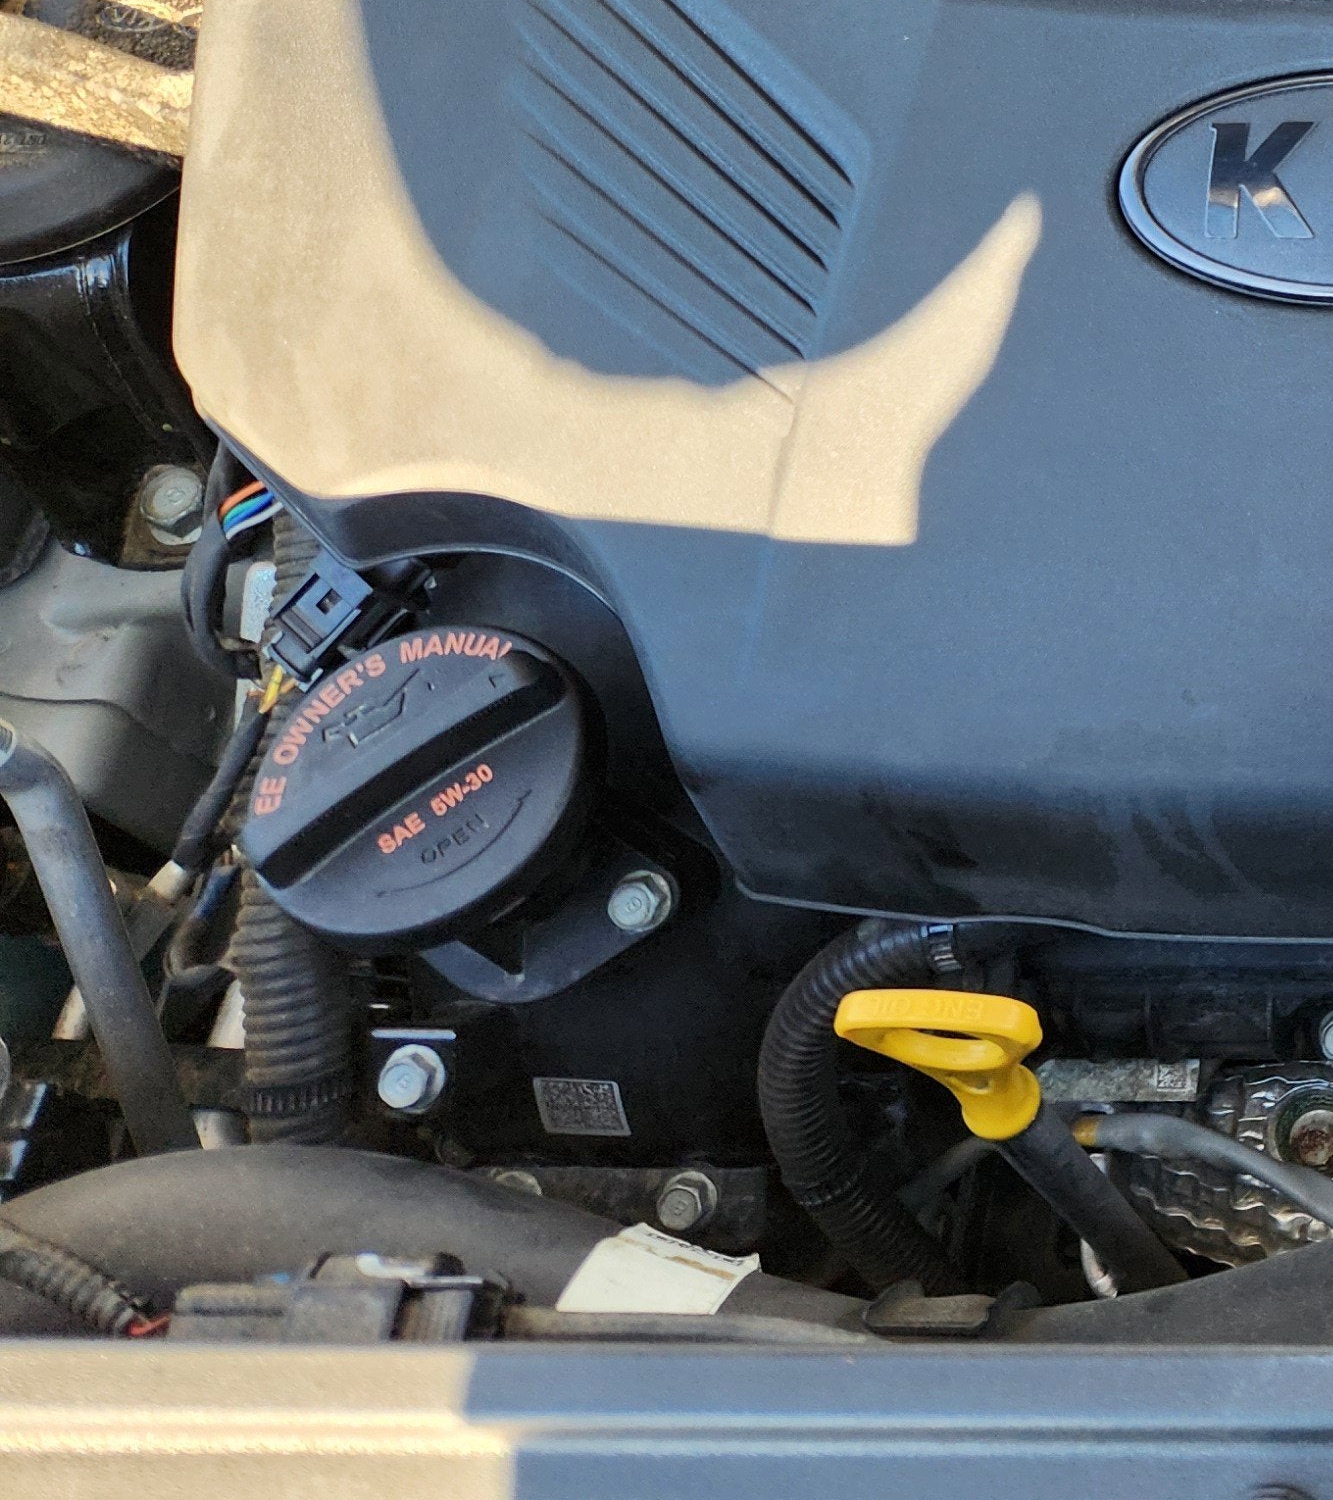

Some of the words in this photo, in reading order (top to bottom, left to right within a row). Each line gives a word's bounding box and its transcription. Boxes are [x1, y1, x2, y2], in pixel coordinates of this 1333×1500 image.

[273, 653, 386, 766] OWNER'S
[377, 811, 426, 854] SAE
[419, 812, 491, 865] OPEN
